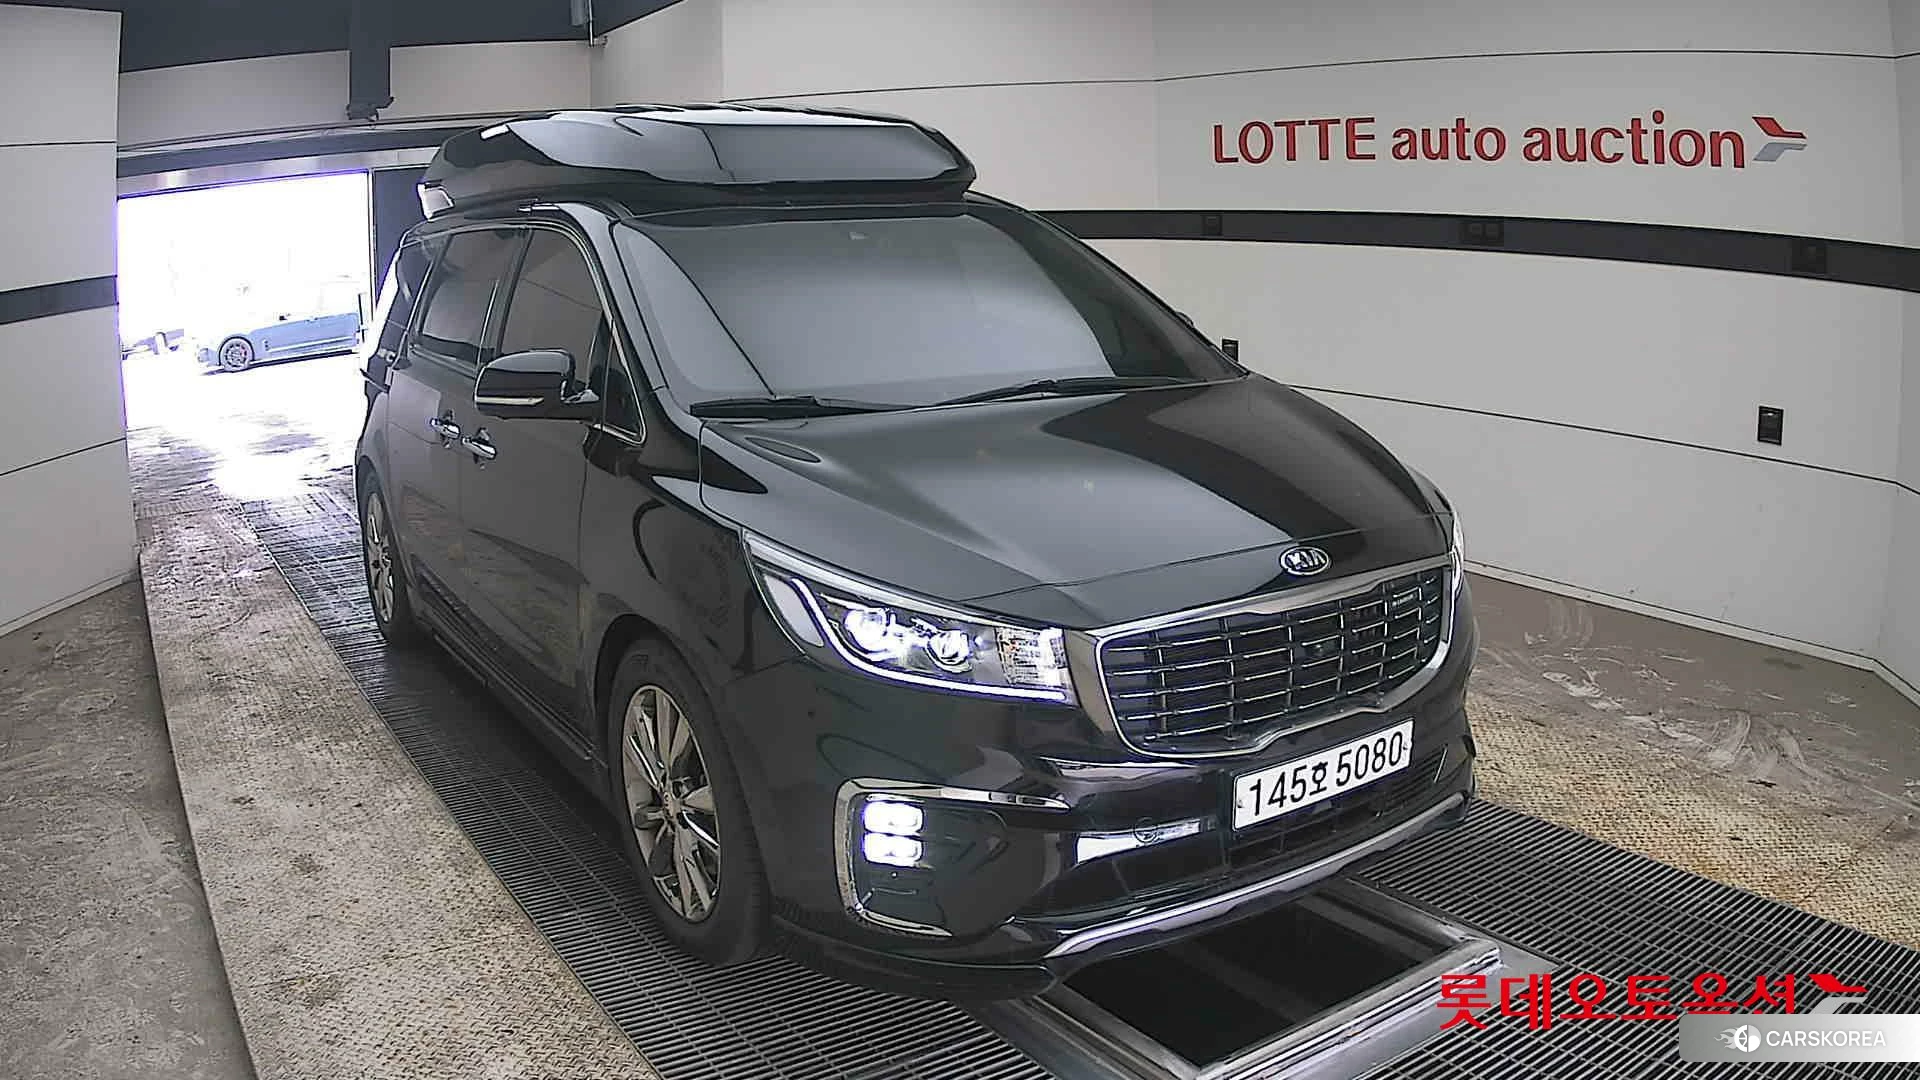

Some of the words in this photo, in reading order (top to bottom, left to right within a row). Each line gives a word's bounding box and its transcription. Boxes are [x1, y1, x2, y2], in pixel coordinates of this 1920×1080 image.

[1212, 116, 1377, 164] LOTTE
[1391, 117, 1507, 163] auto
[1522, 111, 1746, 169] auction
[1286, 549, 1326, 570] KIA
[1249, 761, 1329, 816] 145호
[1336, 731, 1403, 787] 5080
